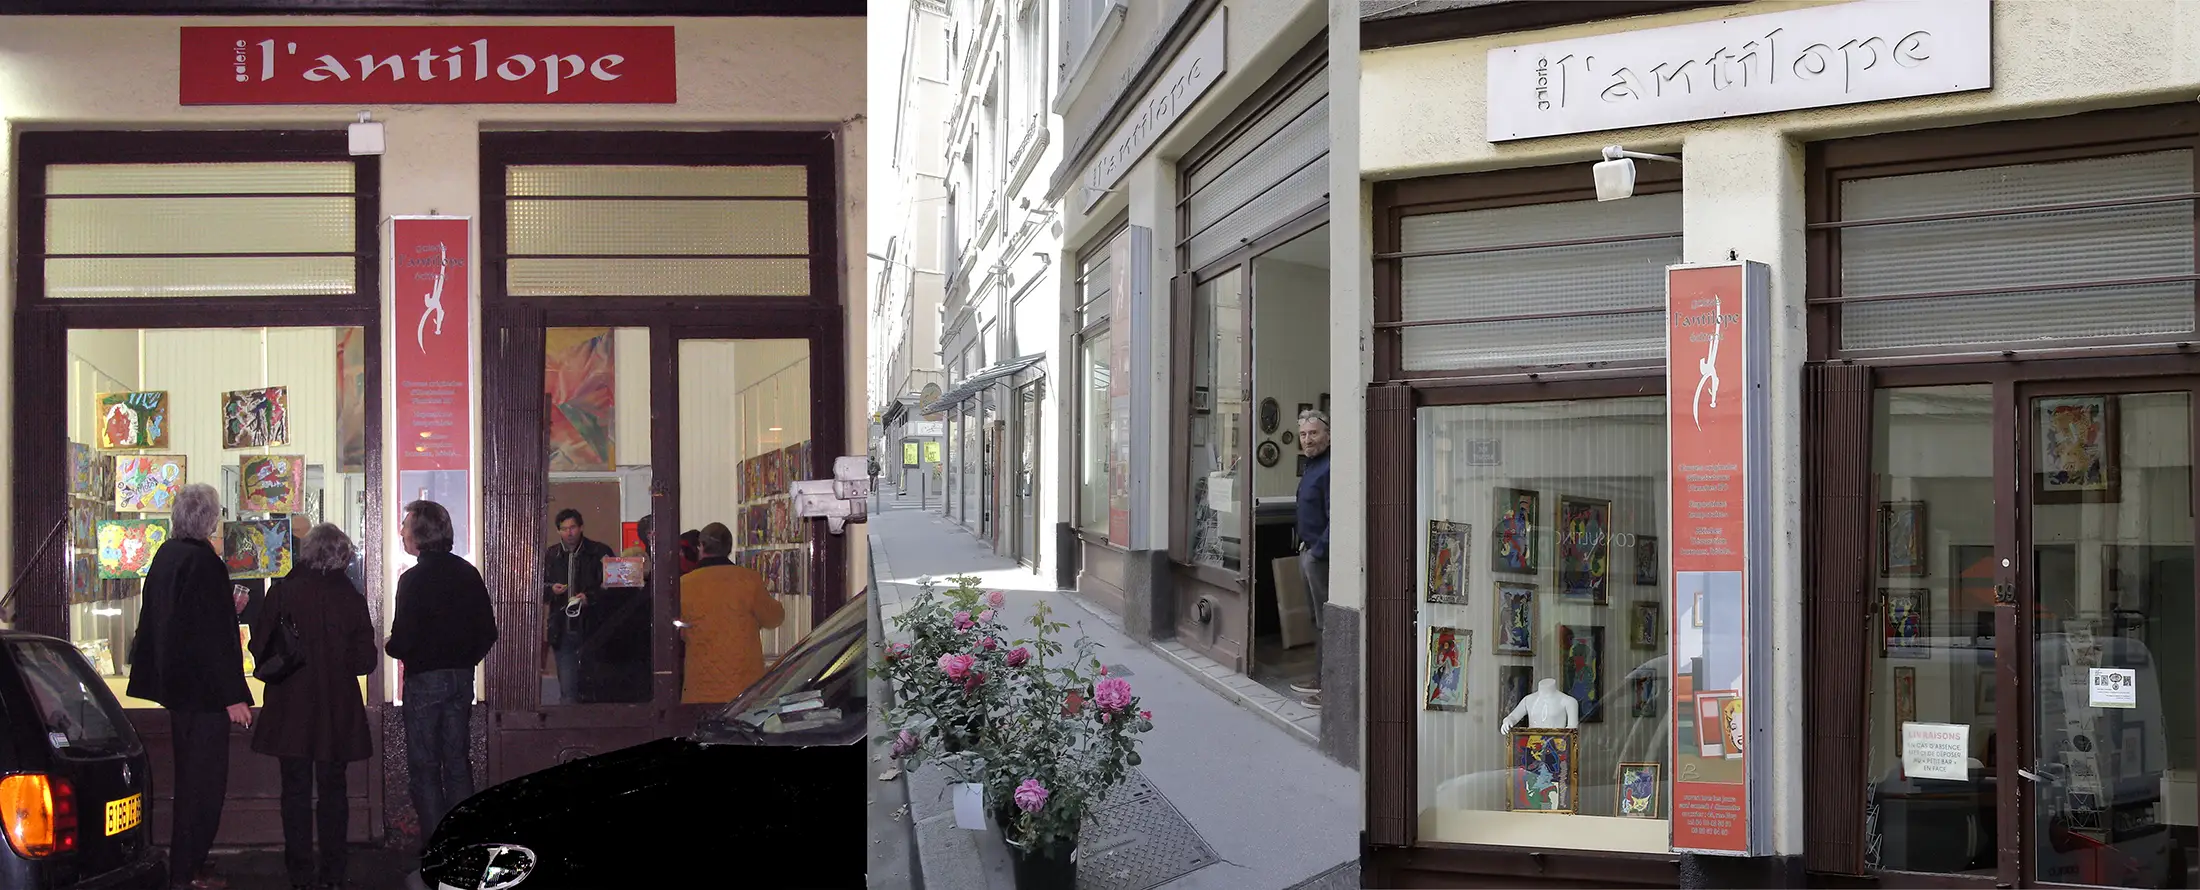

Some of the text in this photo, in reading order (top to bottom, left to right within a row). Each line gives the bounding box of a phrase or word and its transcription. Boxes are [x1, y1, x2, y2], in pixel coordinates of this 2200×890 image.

[233, 39, 249, 82] galerie
[256, 38, 624, 95] l'antilope
[1556, 27, 1933, 107] l'antilope
[1674, 311, 1740, 328] l'antilope
[1997, 583, 2016, 602] 99
[1908, 731, 1961, 740] LIVRAISONS
